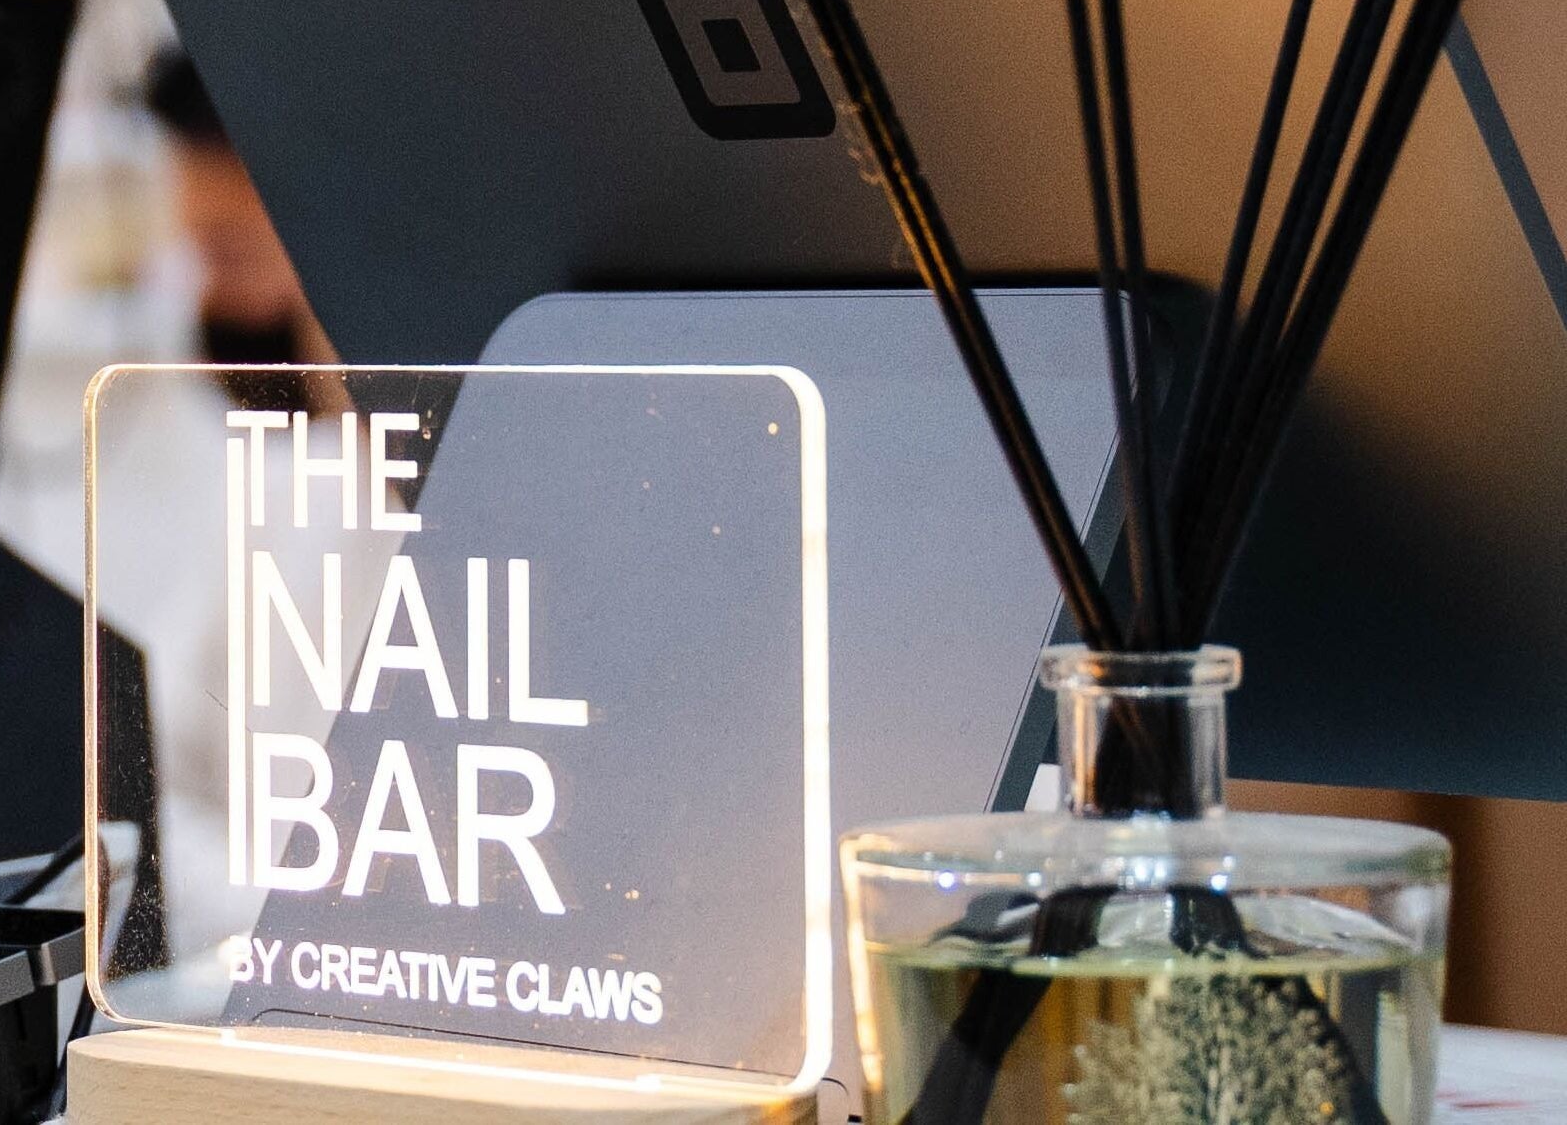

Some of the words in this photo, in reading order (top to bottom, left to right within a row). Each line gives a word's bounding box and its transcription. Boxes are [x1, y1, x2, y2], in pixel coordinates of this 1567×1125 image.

[226, 411, 422, 531] THE
[251, 551, 589, 727] NAIL
[251, 733, 566, 915] BAR
[229, 935, 282, 984] BY
[291, 942, 497, 1008] CREATIVE
[506, 961, 664, 1024] CLAWS
